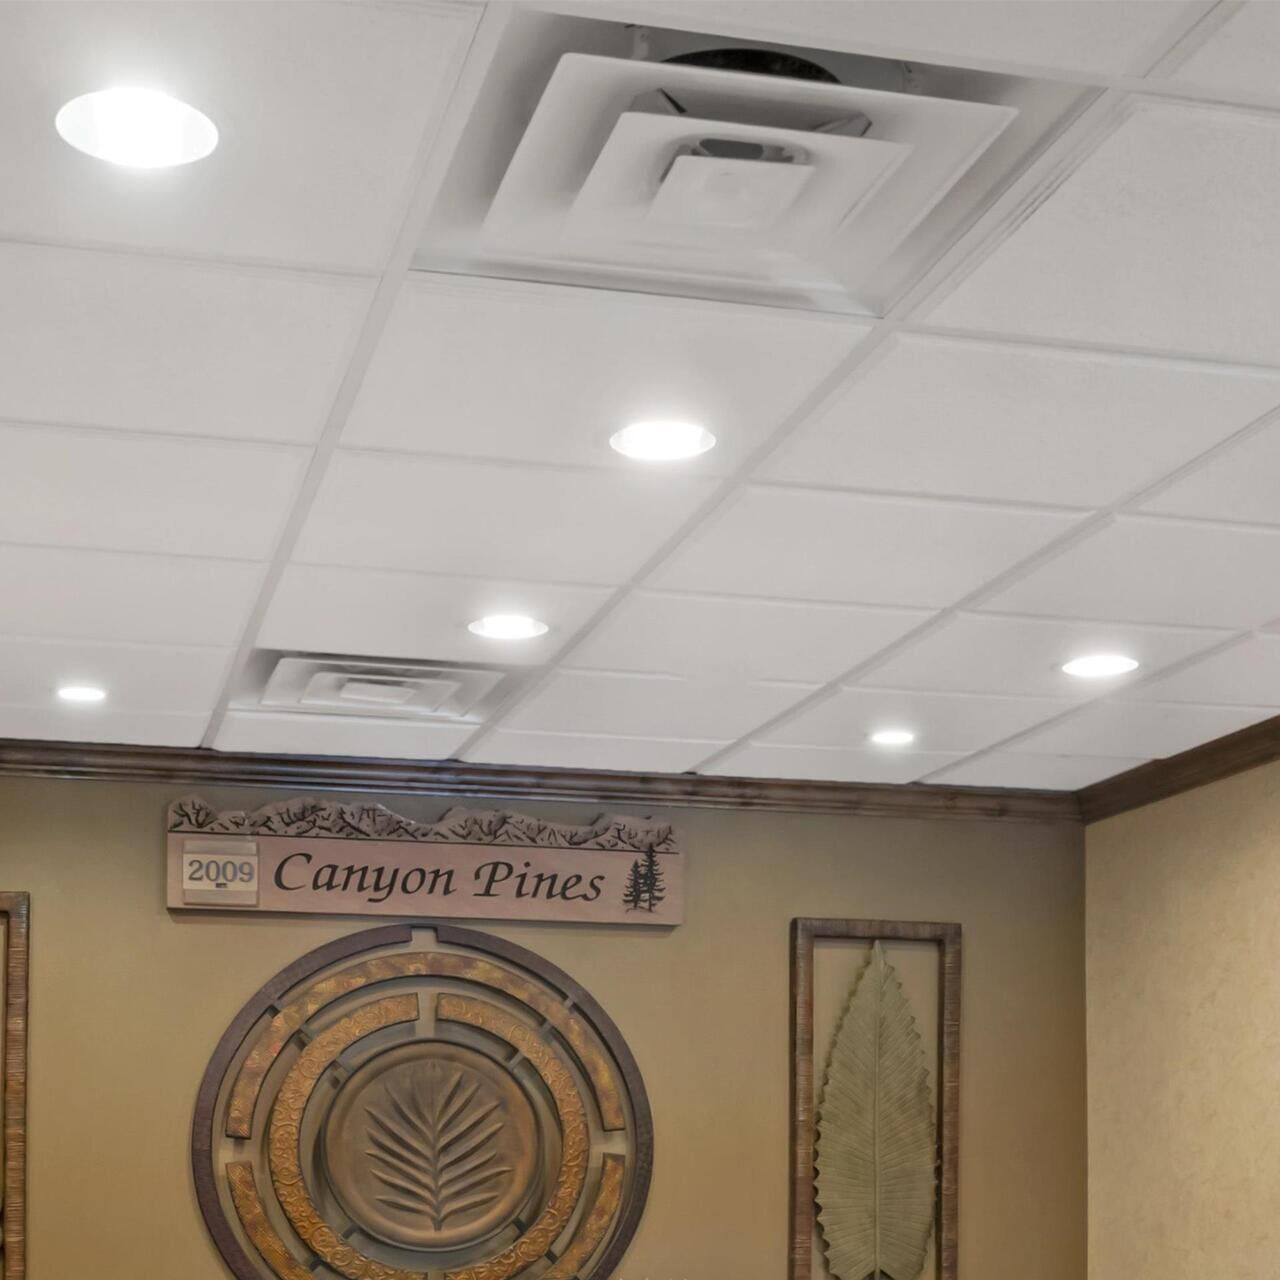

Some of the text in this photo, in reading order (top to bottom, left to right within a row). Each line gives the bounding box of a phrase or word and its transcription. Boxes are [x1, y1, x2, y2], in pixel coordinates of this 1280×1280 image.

[187, 859, 255, 883] 2009
[273, 852, 606, 903] Canyon Pines
